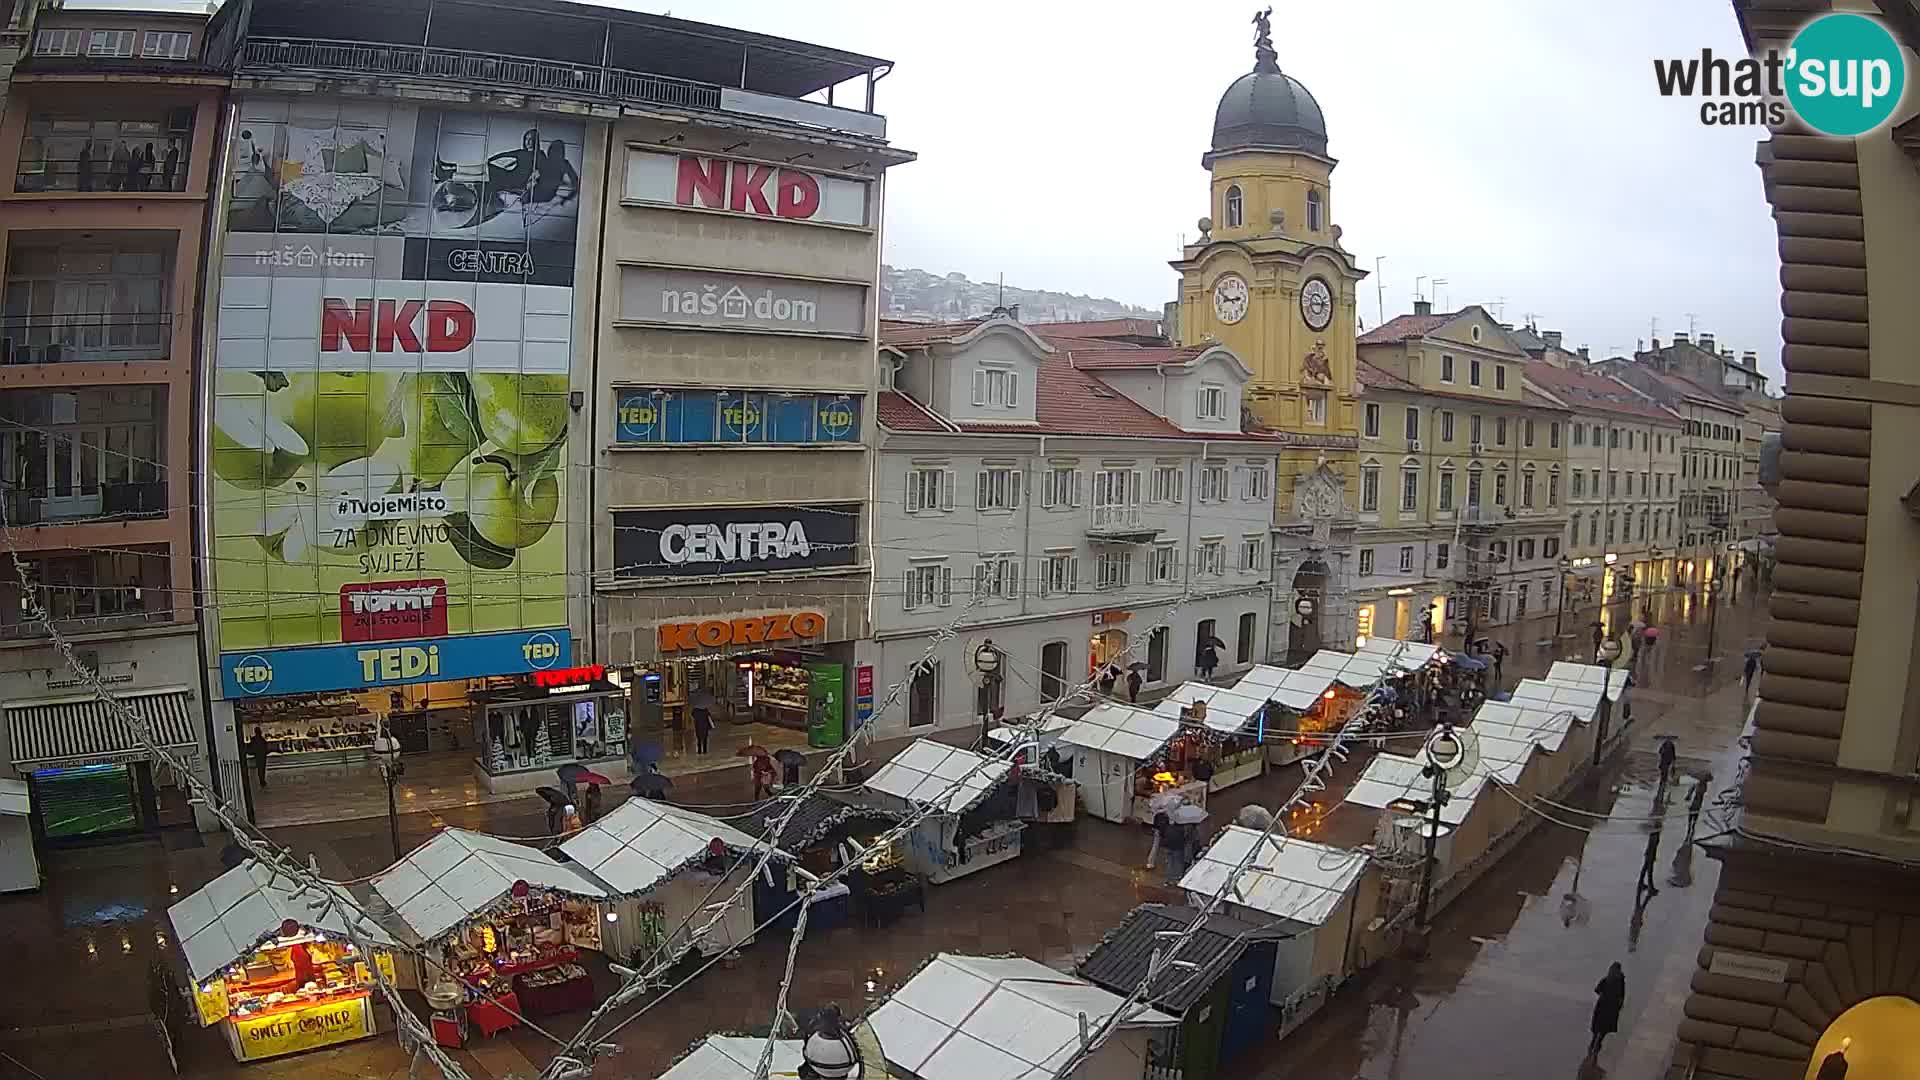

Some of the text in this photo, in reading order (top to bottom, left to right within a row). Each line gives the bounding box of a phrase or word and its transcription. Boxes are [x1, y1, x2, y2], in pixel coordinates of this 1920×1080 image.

[676, 158, 820, 219] NKD
[448, 249, 535, 275] CENTRA
[661, 284, 817, 323] naš dom
[320, 297, 477, 353] NKD
[619, 407, 657, 424] TEDi
[723, 408, 760, 425] TEDi
[819, 410, 853, 426] TEDi
[338, 496, 446, 516] #TvojeMisto
[333, 522, 450, 549] ZA DNEVNO
[659, 520, 811, 563] CENTRA
[359, 548, 426, 575] SVJEŽE
[348, 586, 437, 614] TOMMY
[658, 612, 826, 652] KORZO
[357, 645, 440, 682] TEDi
[522, 643, 560, 659] TEDi
[233, 665, 273, 683] TEDi
[534, 664, 603, 687] TOMMY
[250, 1021, 293, 1041] SWEET
